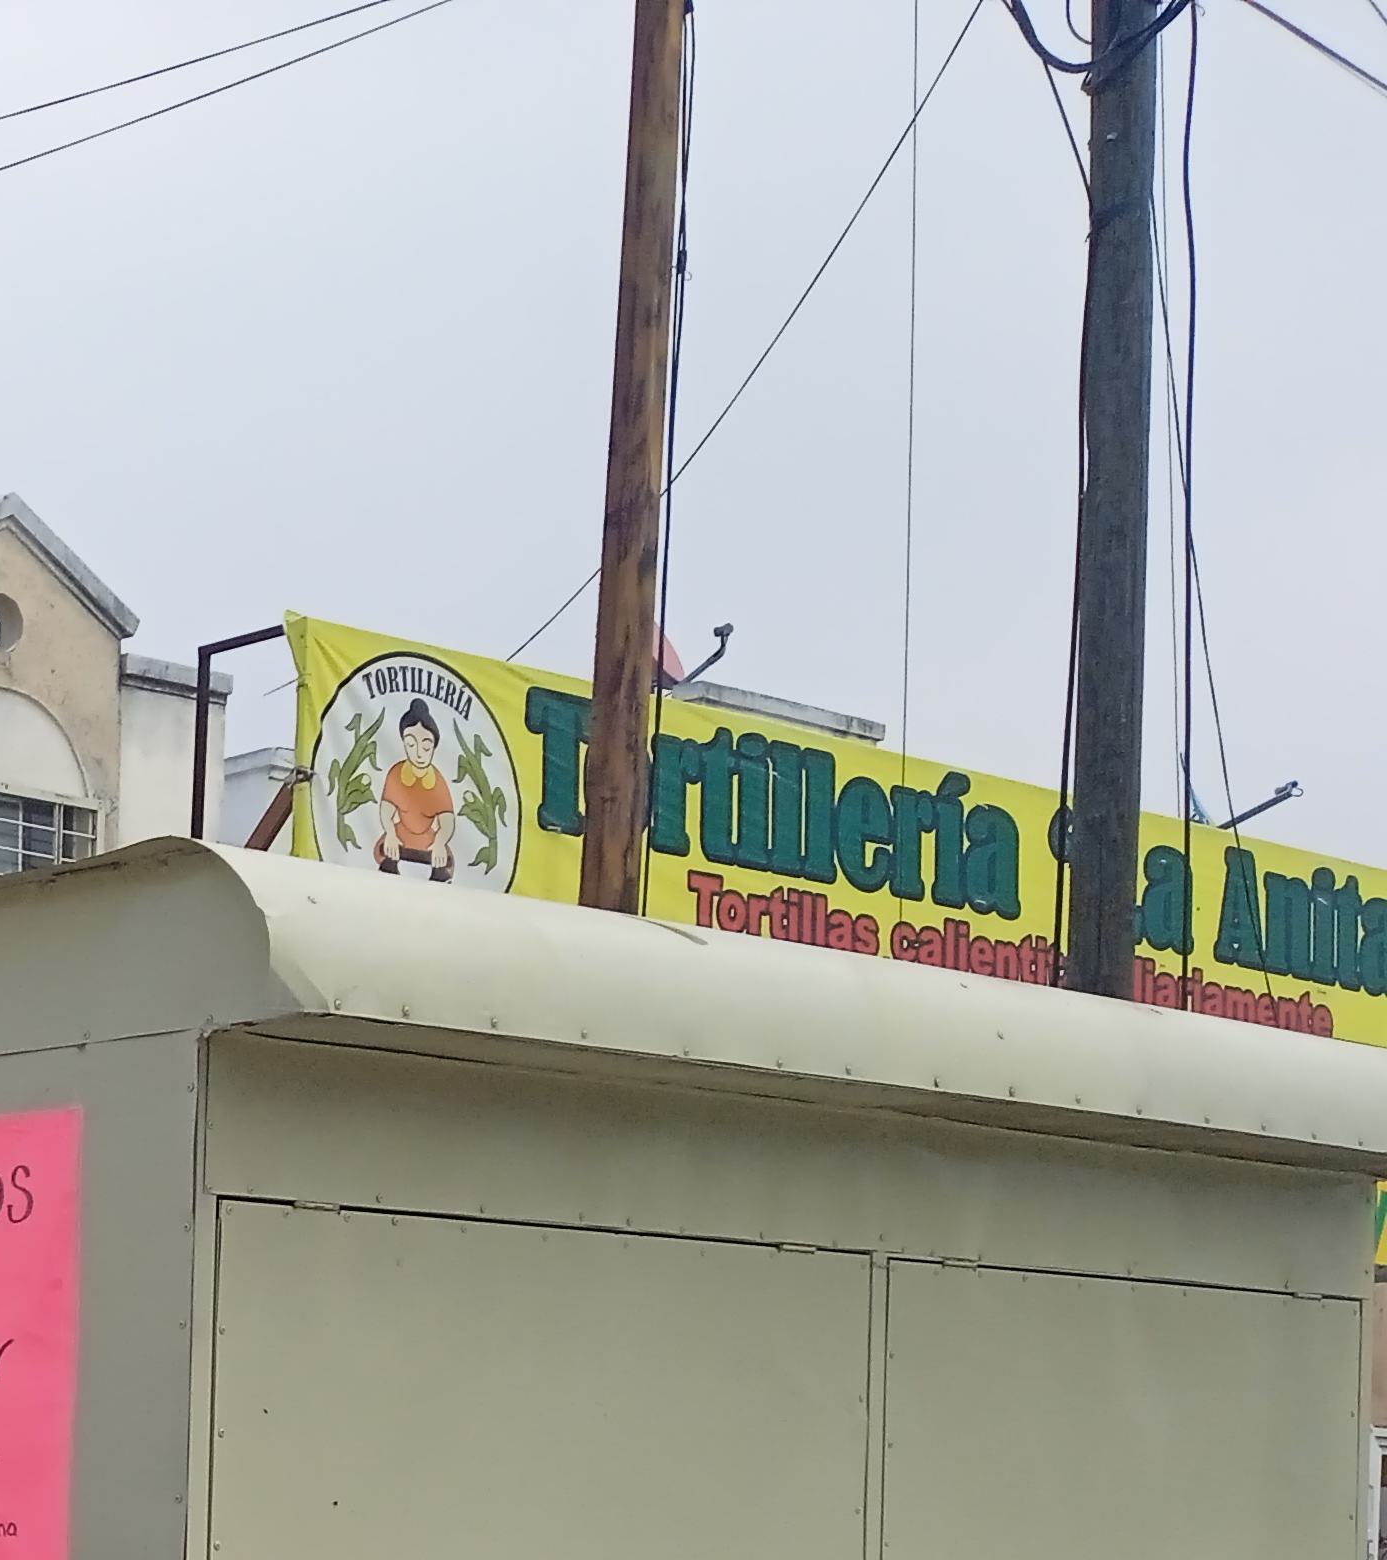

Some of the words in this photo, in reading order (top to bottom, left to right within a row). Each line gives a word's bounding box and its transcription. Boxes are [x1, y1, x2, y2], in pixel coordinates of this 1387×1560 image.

[361, 664, 475, 723] TORTILLERÍA
[526, 685, 1021, 921] Trtillería
[686, 868, 881, 958] Tortillas
